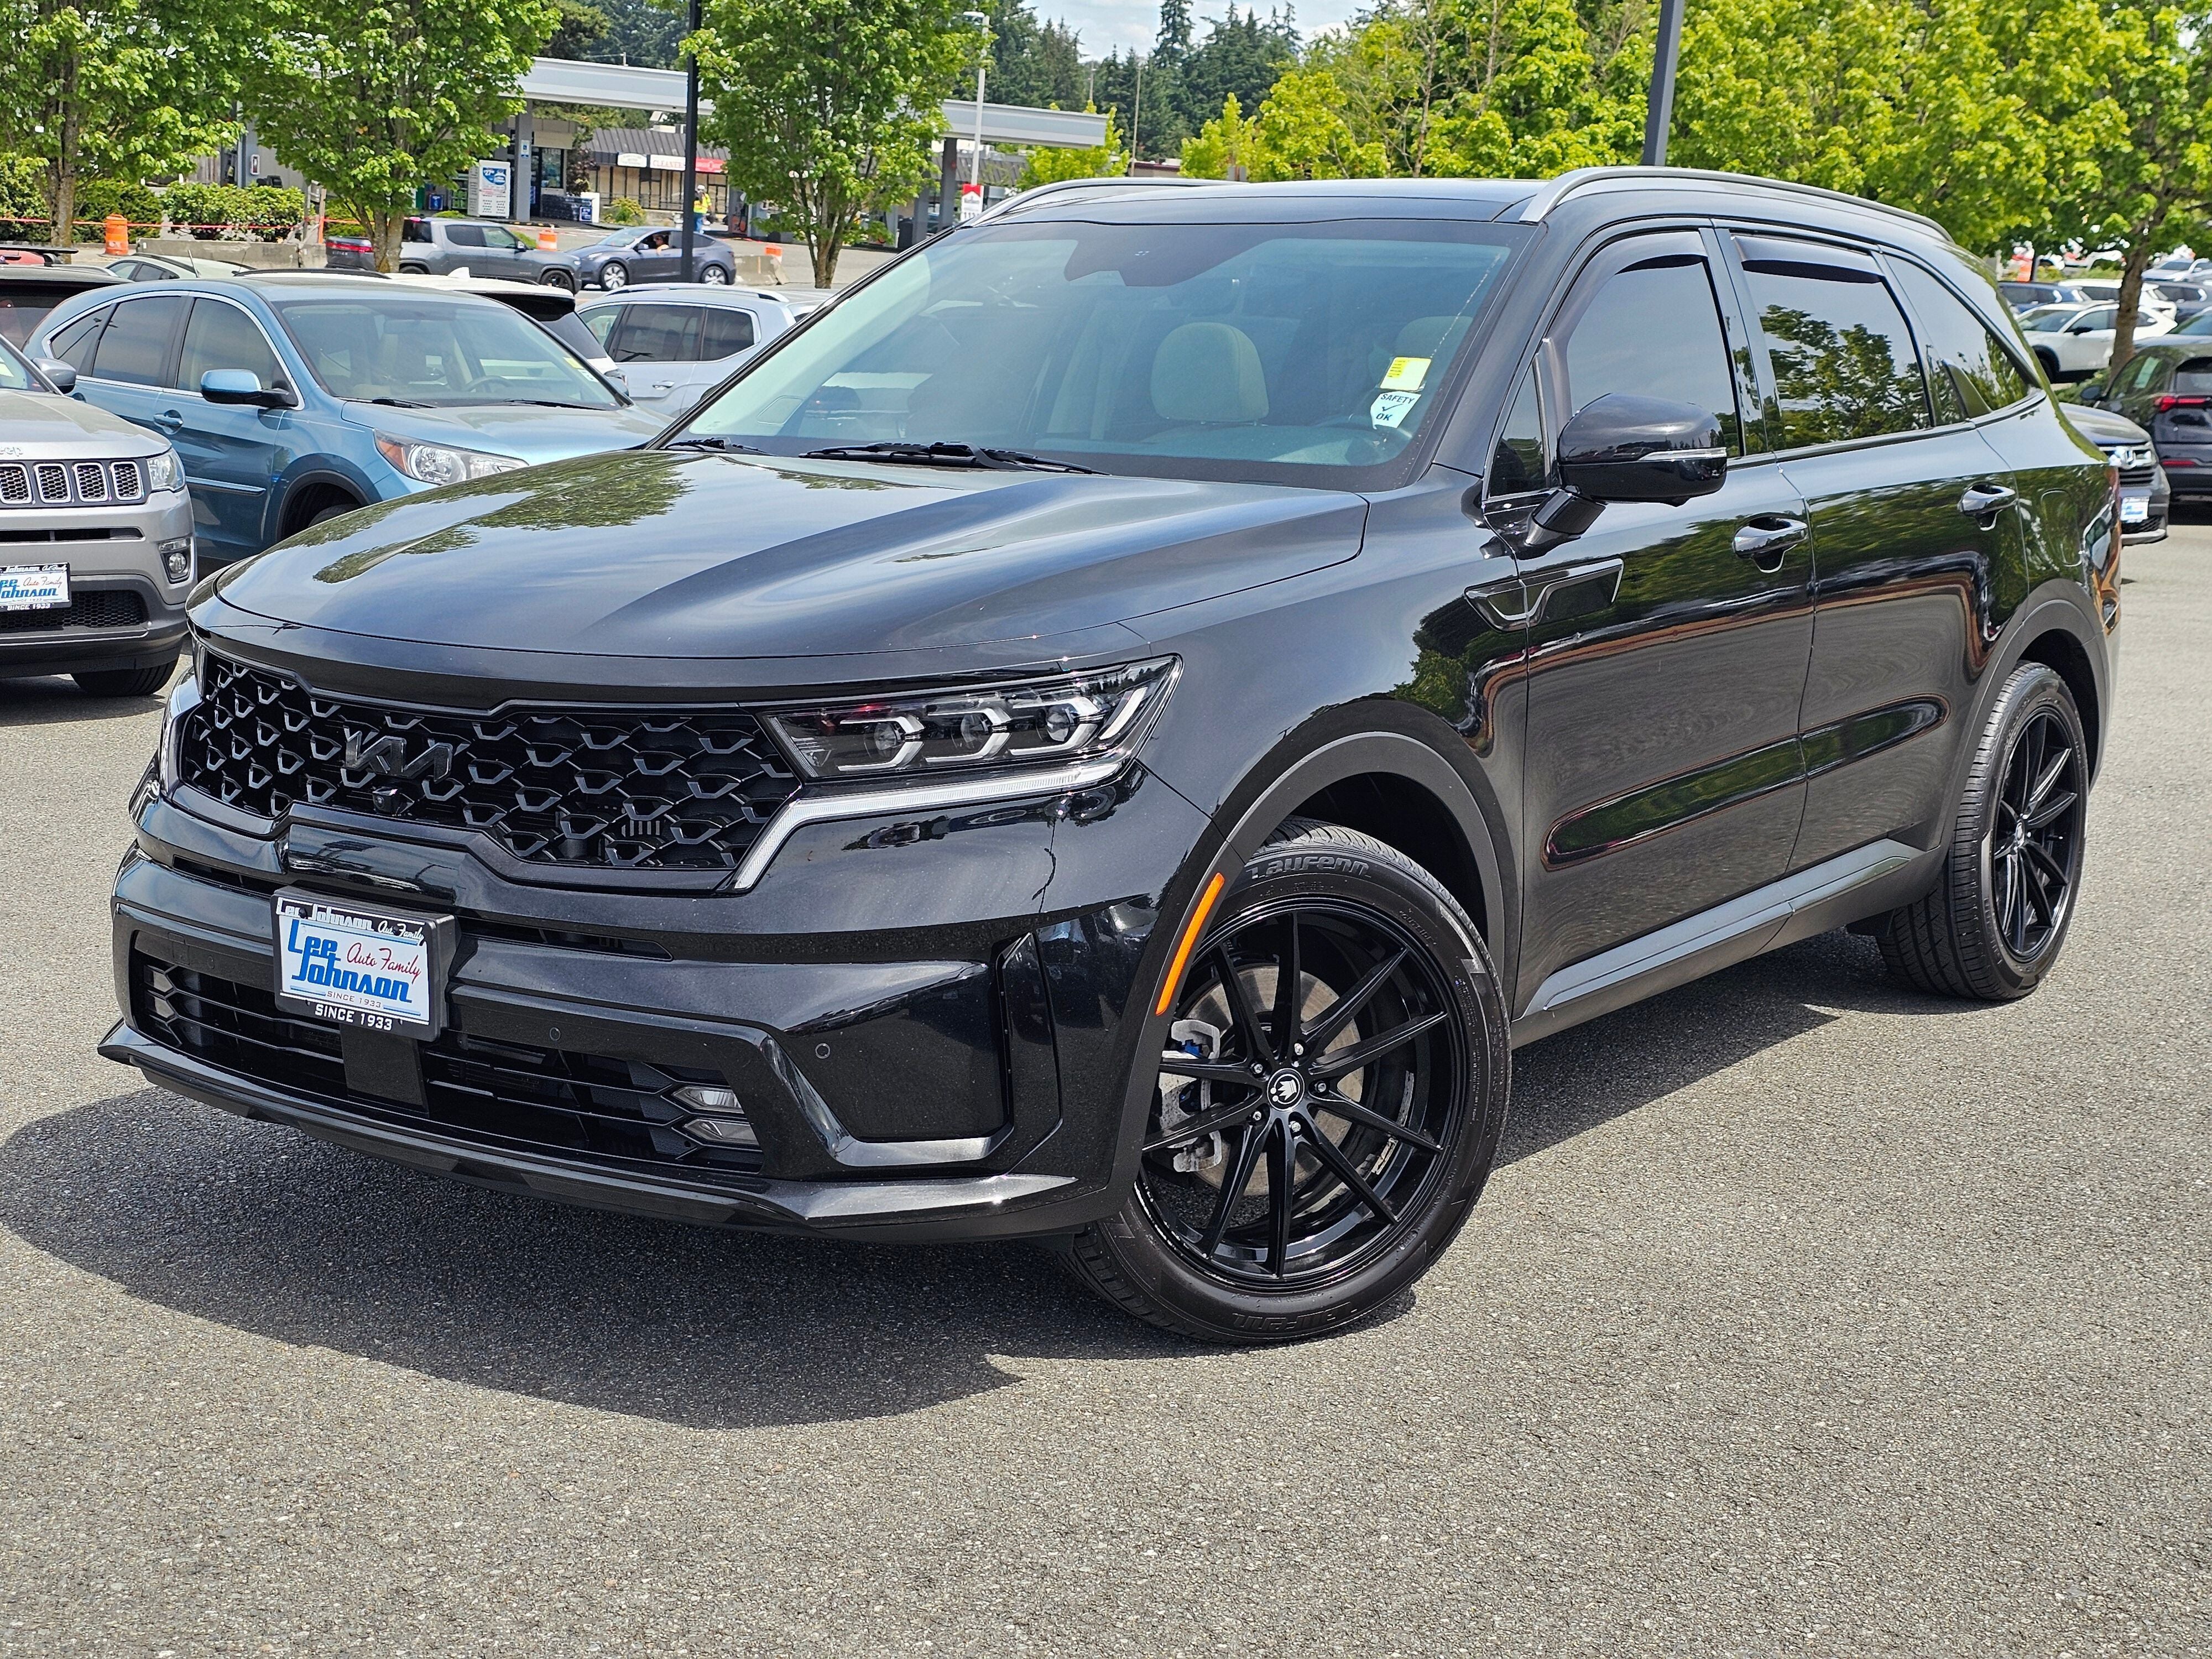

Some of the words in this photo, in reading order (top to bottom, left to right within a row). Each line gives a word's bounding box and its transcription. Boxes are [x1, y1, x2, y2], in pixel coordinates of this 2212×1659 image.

[1381, 394, 1415, 404] SAFETY
[0, 580, 20, 588] ee
[0, 586, 58, 598] ohnson
[308, 904, 374, 931] Johnson
[397, 924, 424, 946] Family
[288, 919, 341, 961] Lee
[347, 942, 377, 967] Auto
[378, 947, 421, 984] Family
[291, 952, 412, 1003] Johnson
[327, 991, 354, 1003] SINCE
[359, 997, 382, 1009] 1933
[315, 1004, 354, 1022] SINCE
[360, 1013, 393, 1031] 1933
